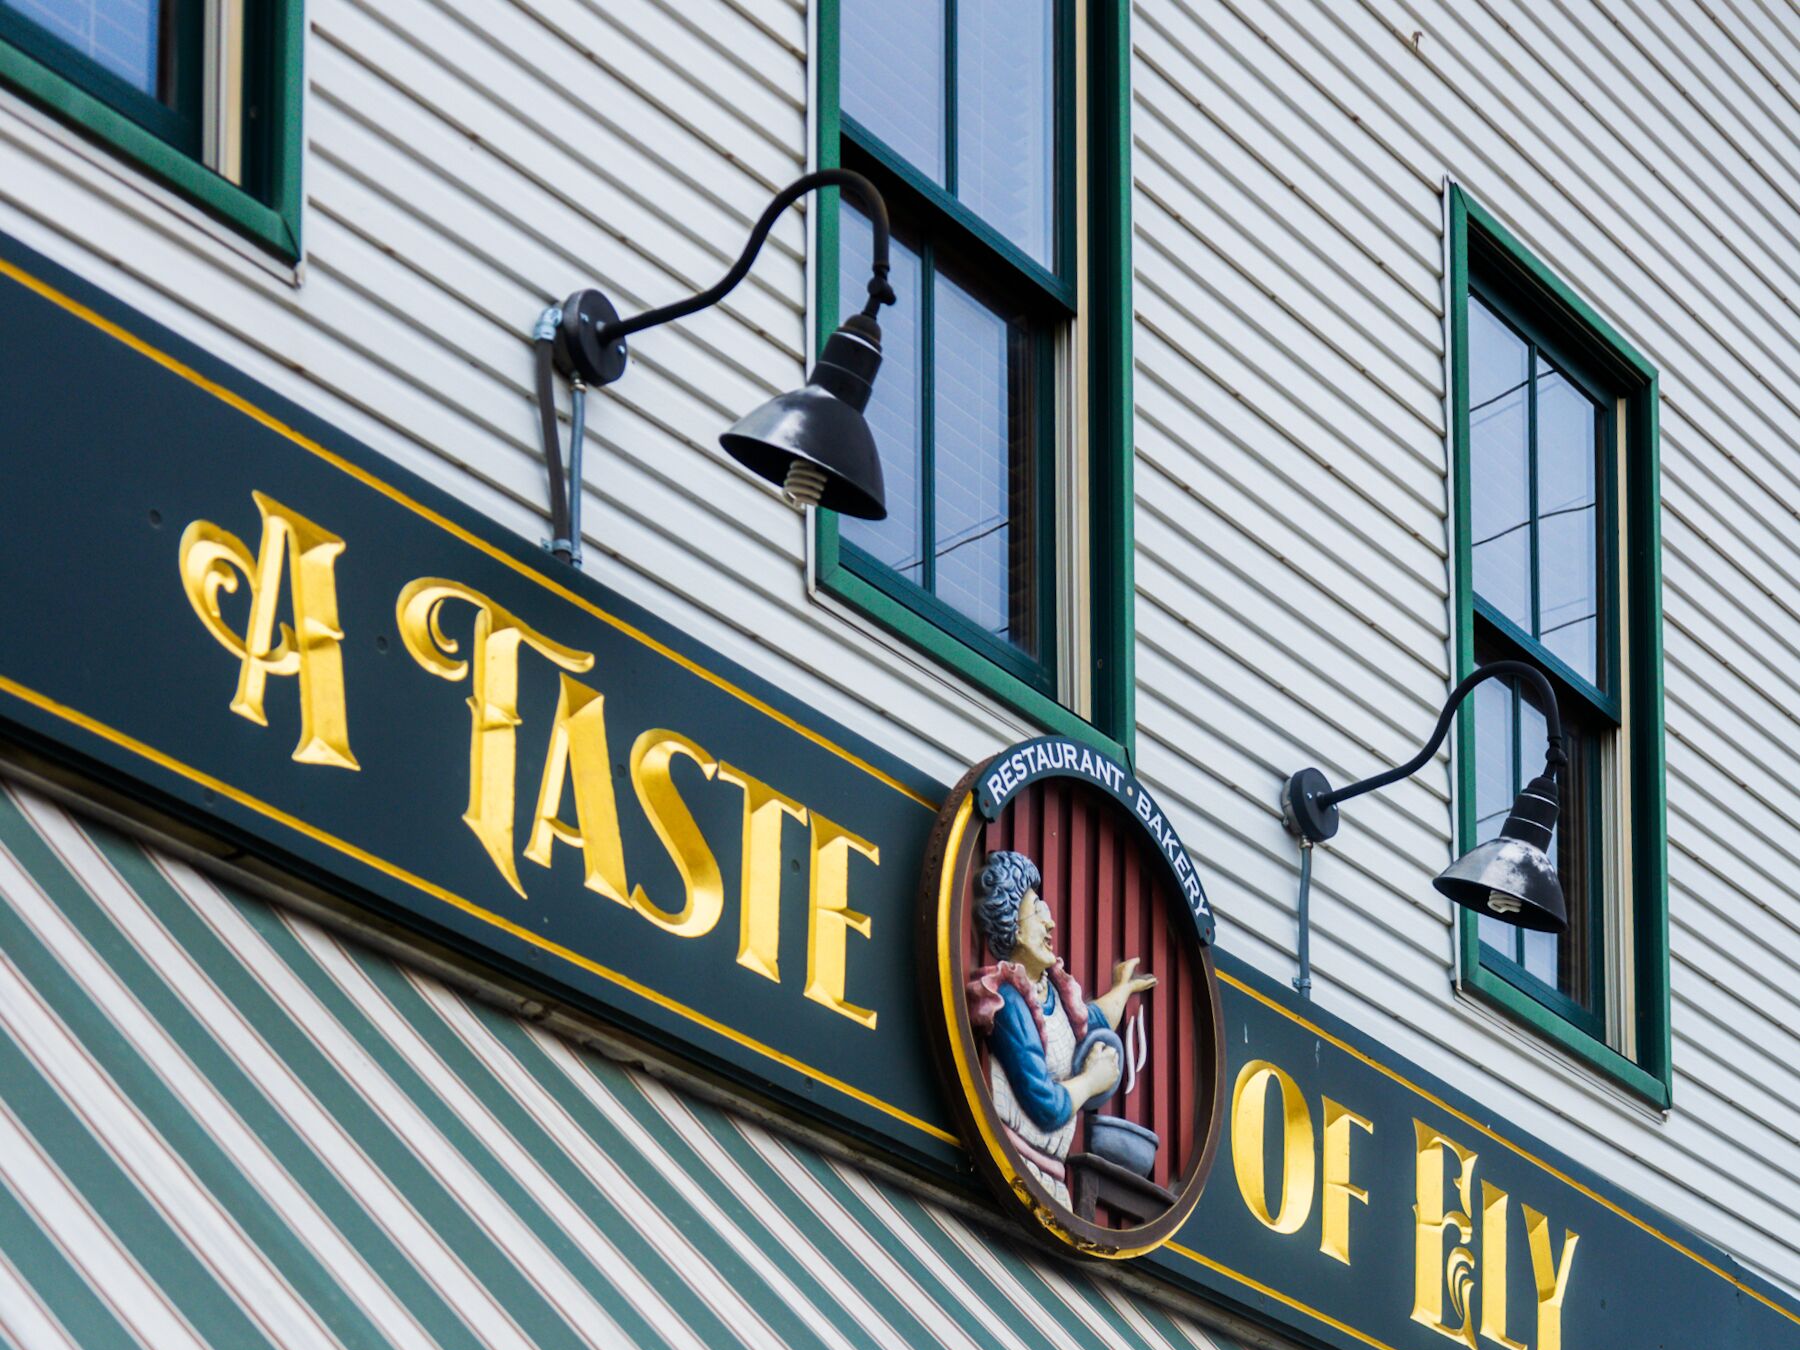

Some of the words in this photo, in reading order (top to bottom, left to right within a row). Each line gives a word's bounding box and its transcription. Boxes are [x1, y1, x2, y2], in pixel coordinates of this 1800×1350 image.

[179, 490, 361, 771] A
[396, 576, 881, 1030] TASTE
[987, 742, 1125, 805] RESTAURANT
[1136, 790, 1212, 919] BAKERY
[1231, 1059, 1374, 1266] OF
